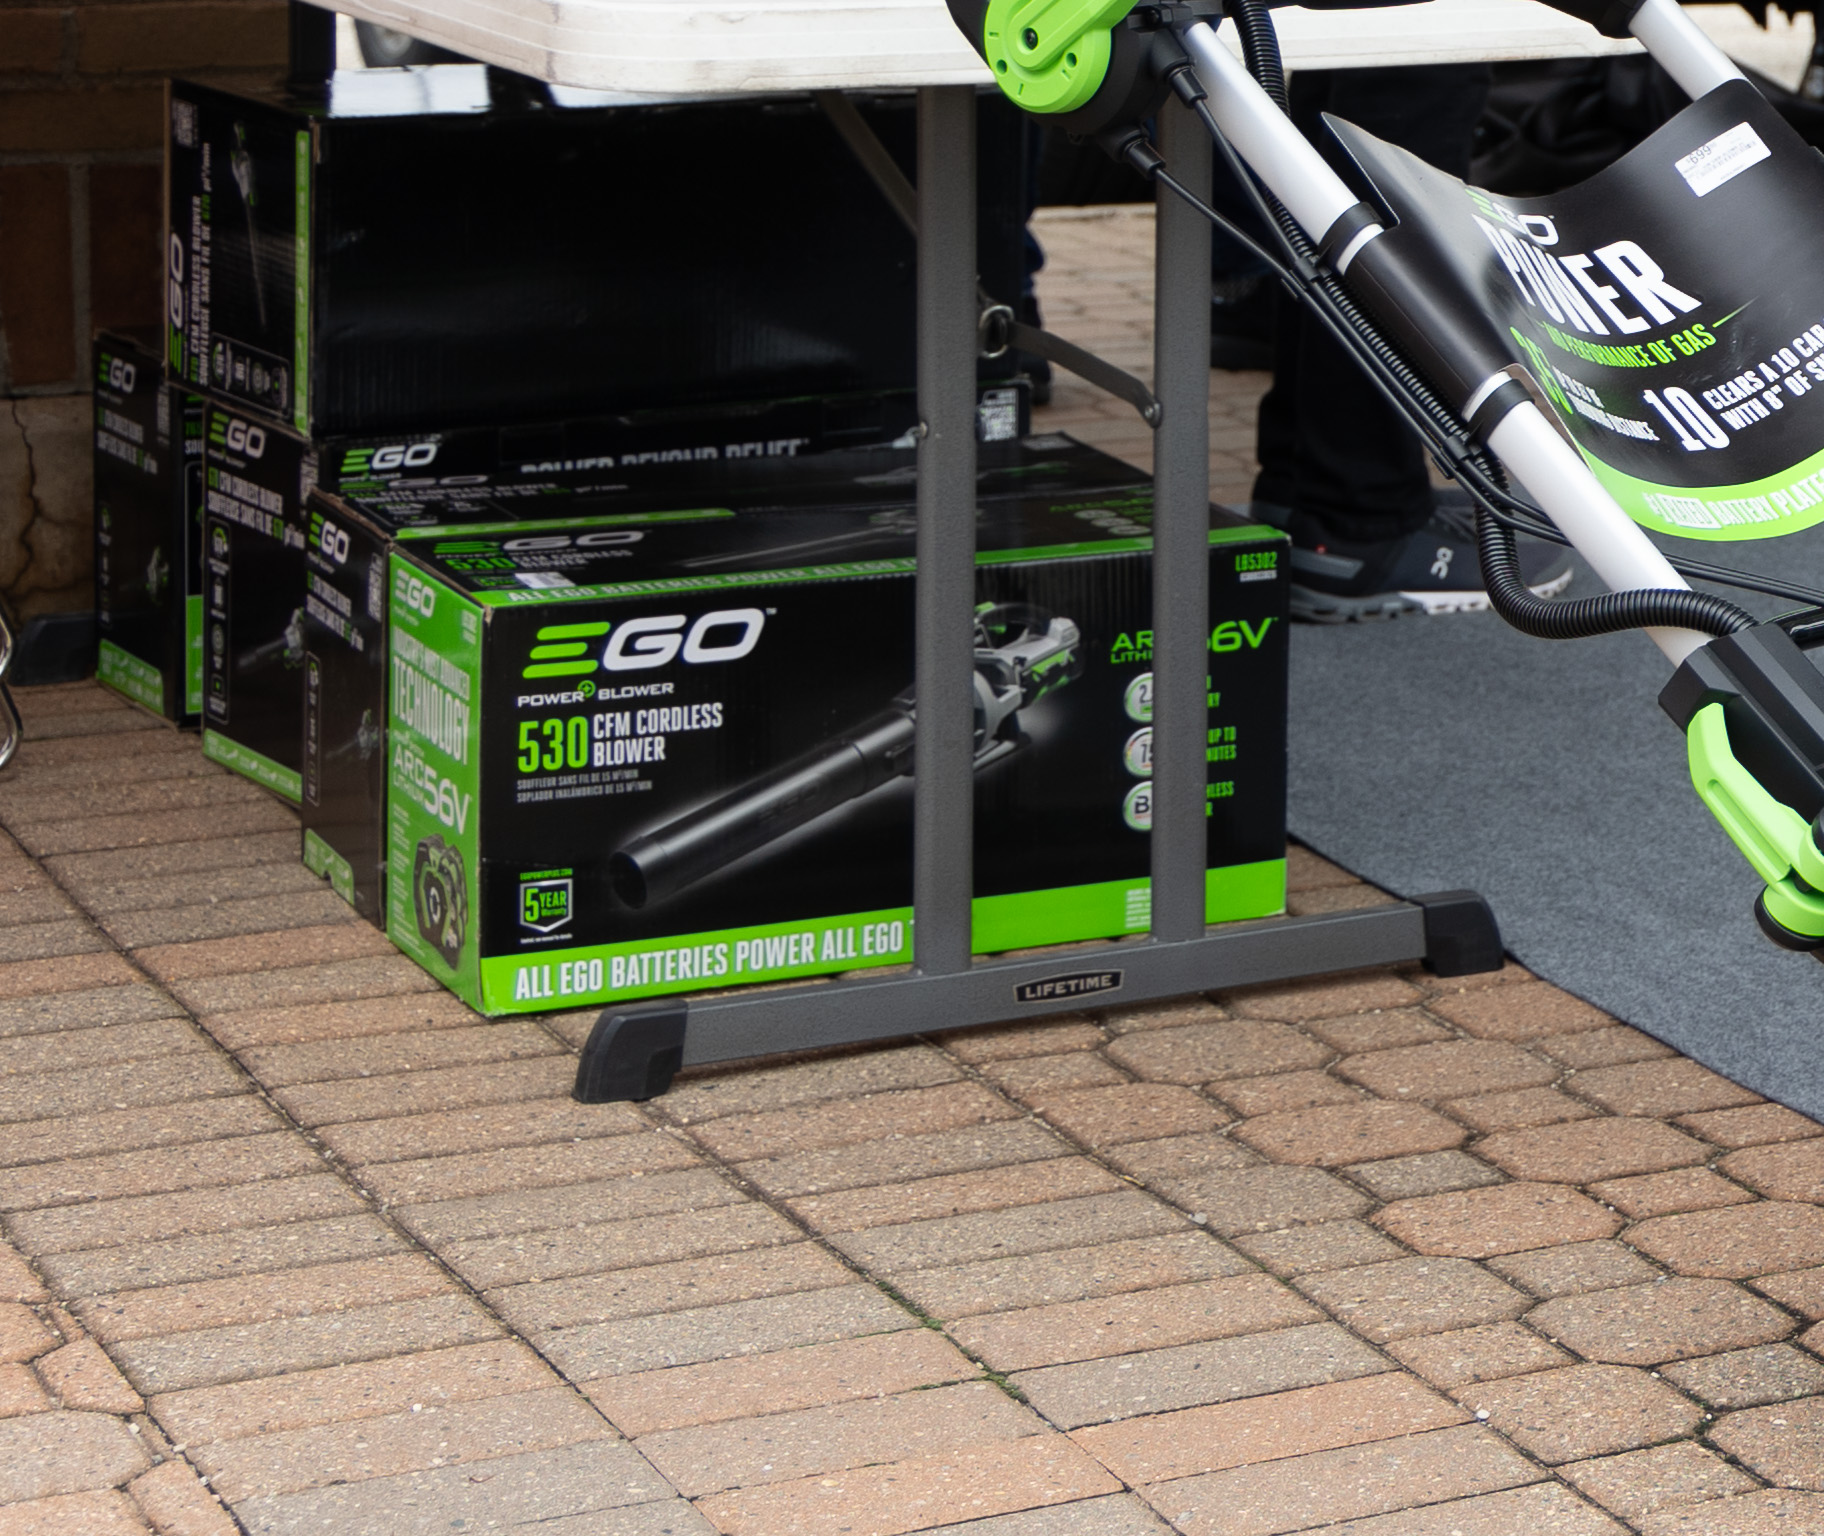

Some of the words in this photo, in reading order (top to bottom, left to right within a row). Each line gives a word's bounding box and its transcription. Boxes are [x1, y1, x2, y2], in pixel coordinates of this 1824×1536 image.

[1464, 188, 1560, 246] EGO
[1471, 213, 1702, 336] POWER
[169, 231, 184, 374] EGO
[1562, 332, 1657, 368] PERFORMANCE
[1646, 339, 1677, 365] OF
[1670, 323, 1717, 357] GAS
[99, 352, 136, 394] EGO
[1702, 370, 1766, 410] CLEARS
[1758, 362, 1781, 384] A
[1770, 347, 1801, 375] 10
[1643, 386, 1731, 452] 10
[1720, 398, 1771, 431] WITH
[1784, 369, 1813, 397] OF
[209, 412, 266, 459] EGO
[340, 443, 438, 473] EGO
[1707, 495, 1780, 526] BATTERY
[308, 511, 350, 564] EGO
[395, 568, 437, 618] EGO
[506, 589, 546, 602] ALL
[552, 584, 597, 599] EGO
[601, 575, 722, 597] BATTERIES
[522, 607, 766, 679] EGO
[1111, 630, 1154, 652] AR
[1111, 650, 1153, 664] LITHI
[1206, 617, 1272, 653] 6V
[394, 655, 470, 766] TECHNOLOGY
[518, 690, 585, 708] POWER
[598, 682, 675, 701] BLOWER
[593, 711, 631, 739] CFM
[636, 702, 723, 735] CORDLESS
[518, 716, 588, 773] 530
[593, 736, 666, 767] BLOWER
[393, 743, 426, 788] ARC
[424, 764, 471, 836] 56V
[558, 774, 577, 787] SANS
[525, 887, 540, 922] 5
[539, 890, 567, 908] YEAR
[515, 966, 554, 1001] ALL
[559, 957, 603, 996] EGO
[611, 943, 728, 989] BATTERIES
[735, 932, 815, 972] POWER
[821, 927, 857, 962] ALL
[862, 920, 903, 958] EGO
[1025, 974, 1113, 999] LIFETIME
